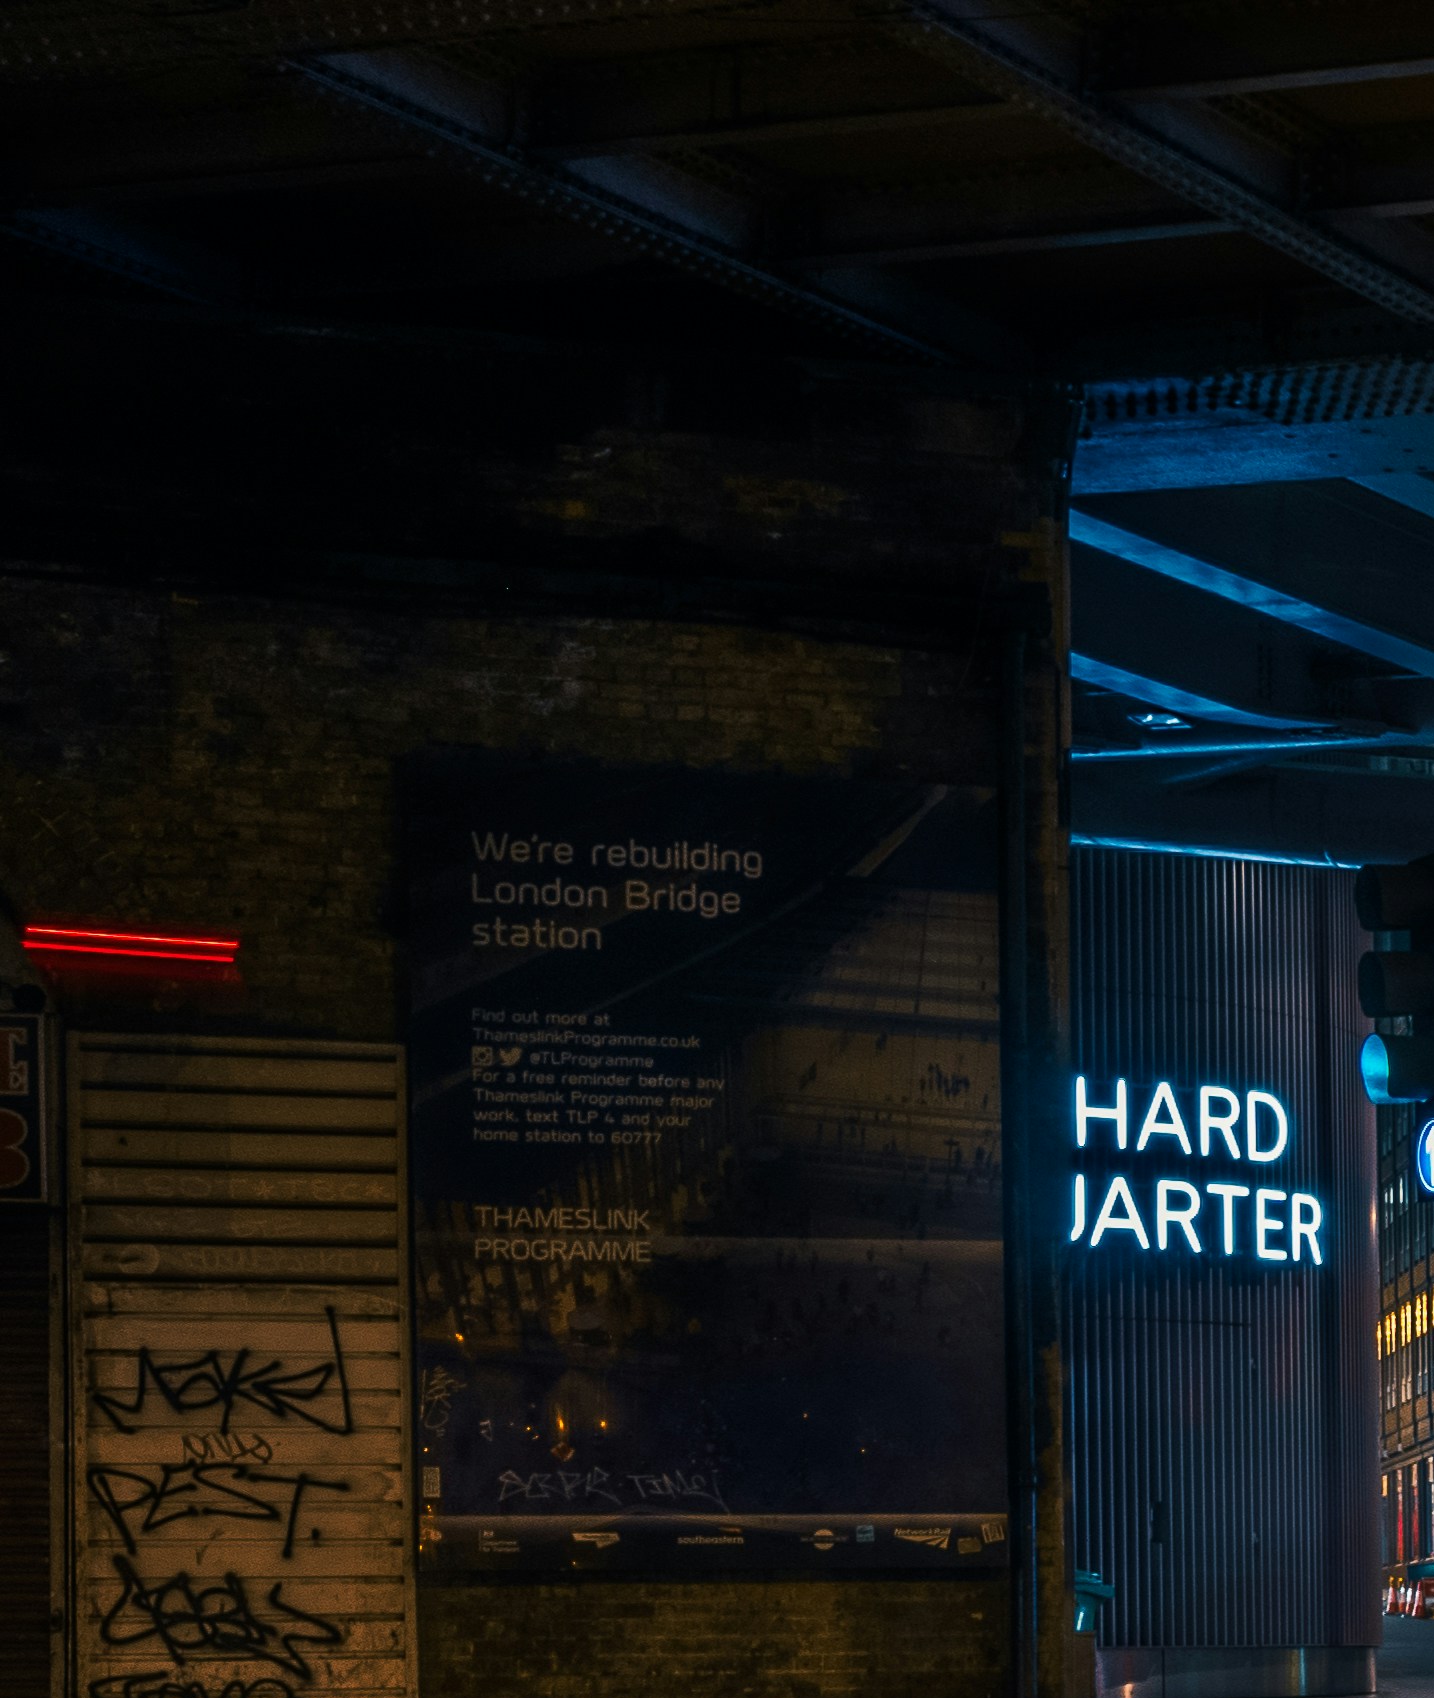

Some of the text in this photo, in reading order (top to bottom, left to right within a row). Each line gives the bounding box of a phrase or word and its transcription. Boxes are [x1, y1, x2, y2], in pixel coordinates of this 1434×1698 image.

[471, 831, 763, 879] We're rebuilding
[471, 872, 741, 919] London Bridge
[472, 916, 602, 950] station
[471, 1007, 610, 1027] Find out more at
[473, 1027, 701, 1048] ThameslinkProgramme.co.uk
[529, 1051, 654, 1069] @TLProgramme
[472, 1068, 724, 1091] For a free reminder before any
[474, 1088, 714, 1110] Thameslink Programme major
[525, 1109, 559, 1123] text
[566, 1109, 598, 1125] TLP
[604, 1112, 615, 1125] 4
[621, 1112, 650, 1126] and
[656, 1115, 691, 1129] your
[1075, 1075, 1289, 1164] HARD
[473, 1127, 662, 1145] home station to 60777
[474, 1206, 650, 1230] THAMESLINK
[474, 1238, 652, 1263] PROGRAMME
[676, 1535, 744, 1545] southeastern
